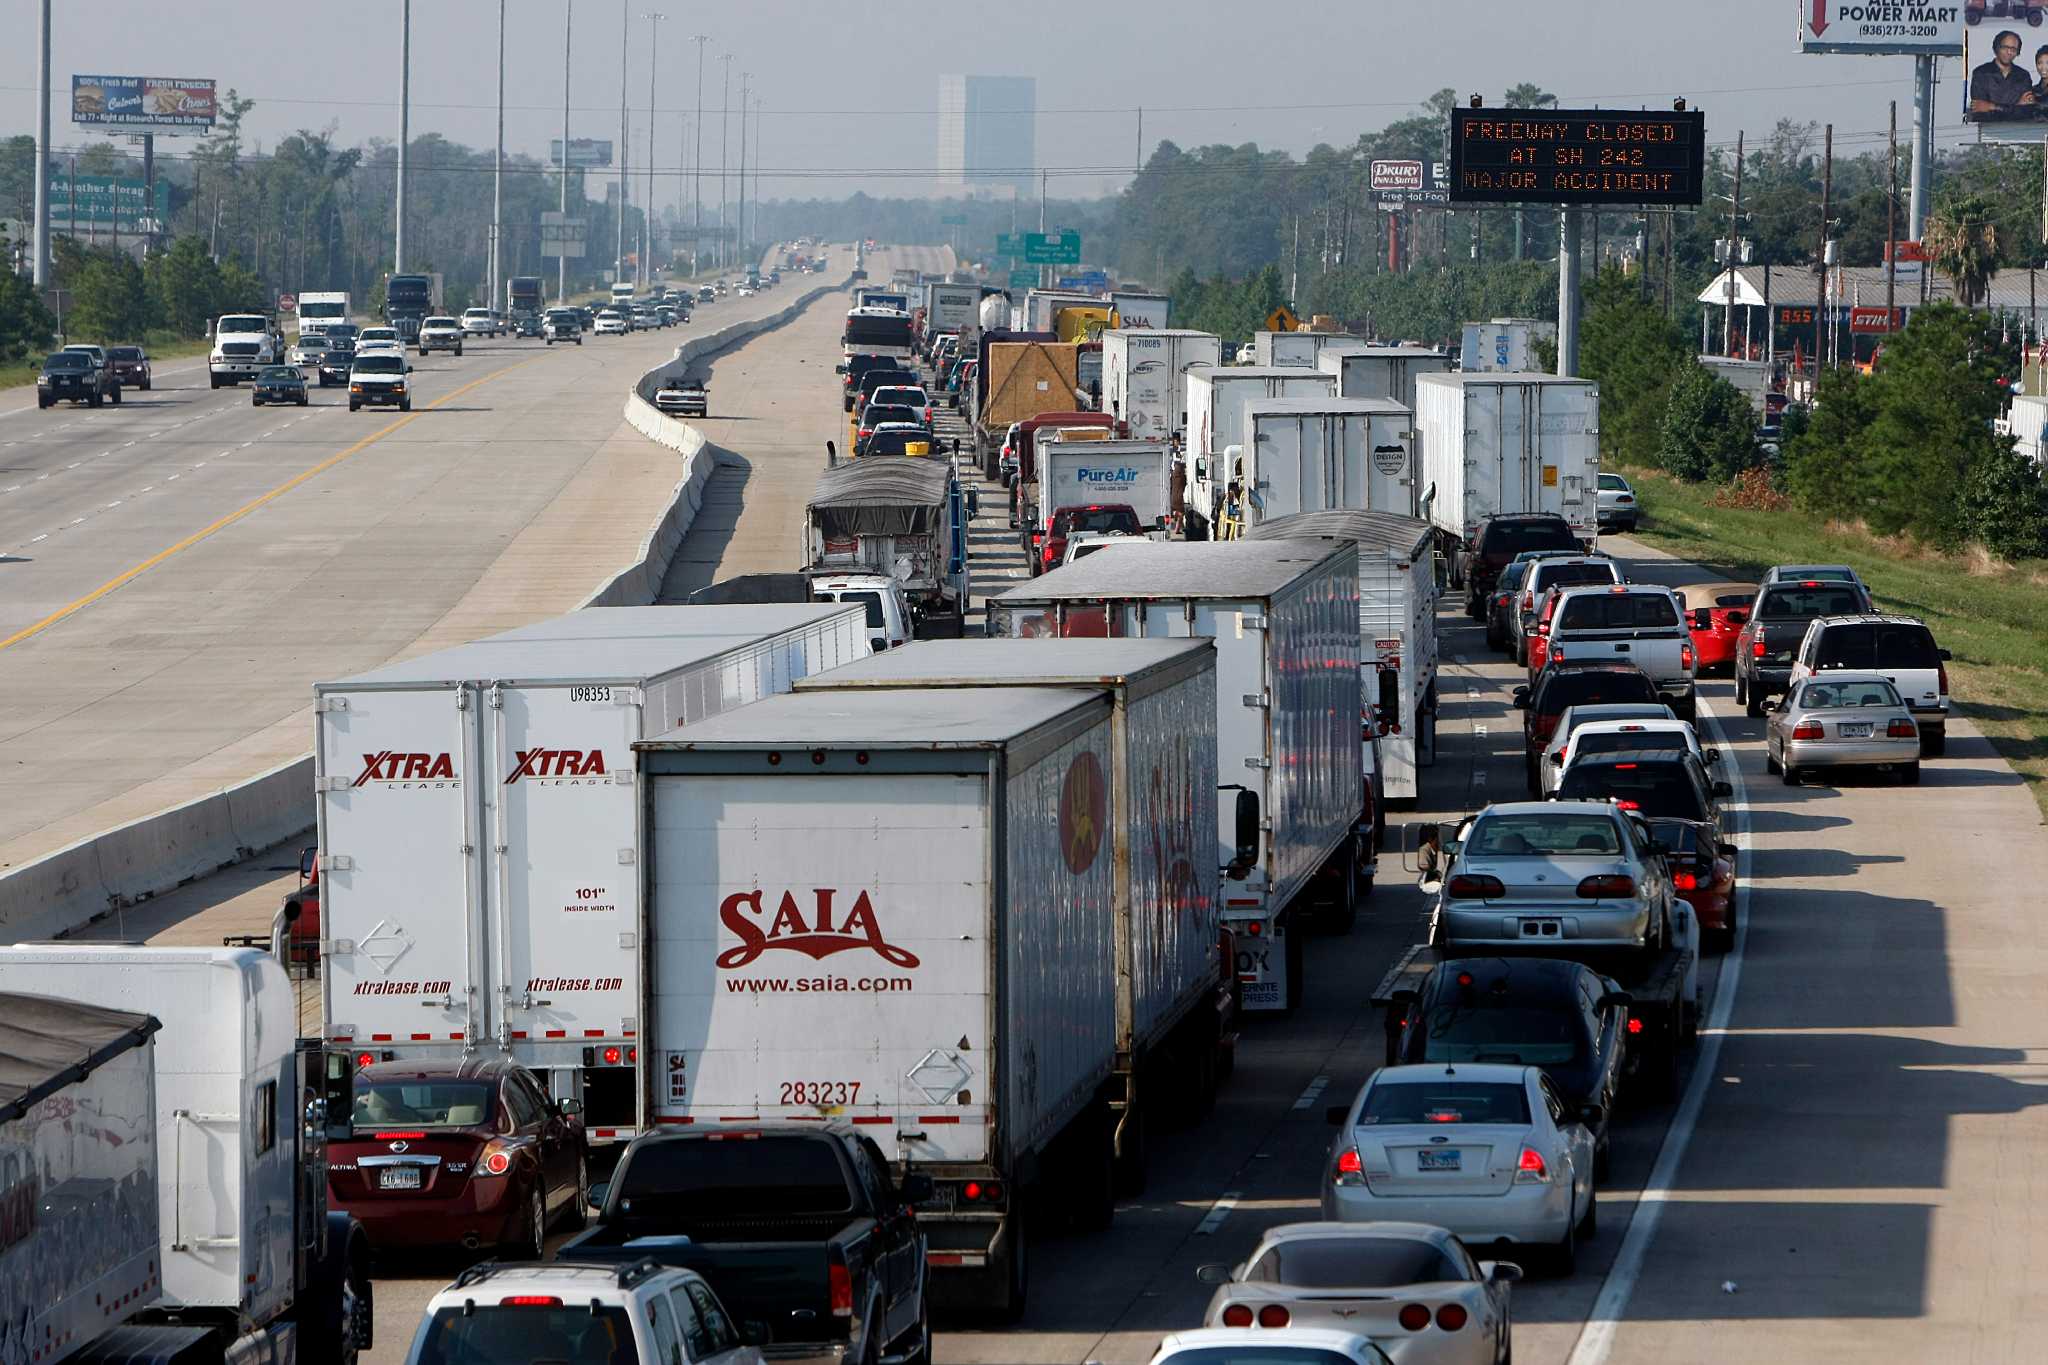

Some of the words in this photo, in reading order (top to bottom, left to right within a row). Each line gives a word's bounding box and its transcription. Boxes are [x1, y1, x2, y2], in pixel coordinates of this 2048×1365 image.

[1840, 7, 1902, 21] POWER
[1908, 8, 1958, 22] MART
[1859, 25, 1938, 37] (936)273-3200
[1465, 122, 1568, 140] FREEWAY
[1586, 124, 1674, 141] CLOSED
[1510, 148, 1537, 164] AT
[1555, 149, 1584, 165] SH
[1600, 150, 1643, 166] 242
[1464, 172, 1537, 188] MAJOR
[1554, 173, 1673, 190] ACCIDENT
[1855, 314, 1893, 325] STIH
[1078, 468, 1137, 481] PureAir
[570, 687, 610, 702] U98353
[351, 751, 455, 787] XTRA
[503, 748, 605, 785] XTRA
[716, 889, 920, 968] SAIA
[353, 980, 450, 995] xtralease.com
[525, 977, 622, 992] xtralease.com
[726, 974, 913, 992] www.saia.com
[1243, 993, 1280, 1002] PRESS
[780, 1082, 861, 1104] 283237
